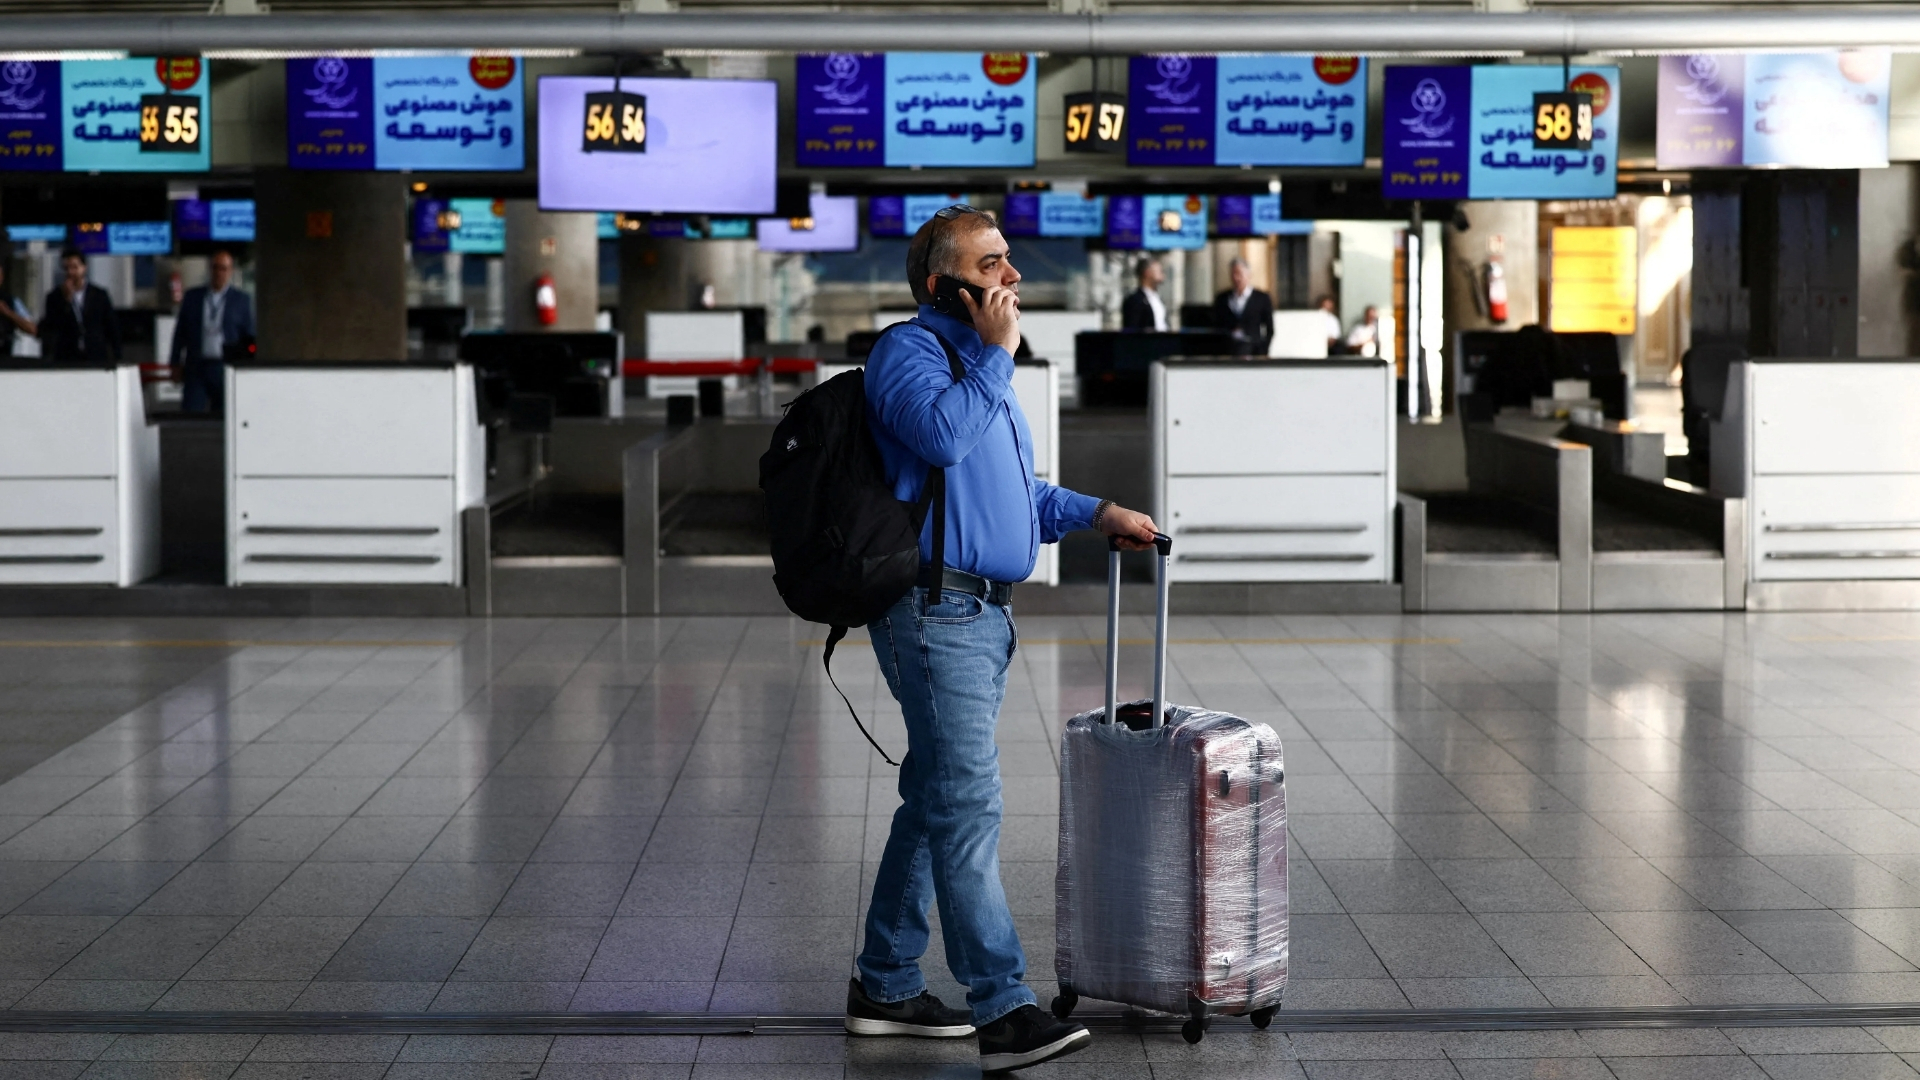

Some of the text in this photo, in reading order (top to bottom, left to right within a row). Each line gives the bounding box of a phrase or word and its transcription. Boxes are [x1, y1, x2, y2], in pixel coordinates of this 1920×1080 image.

[385, 93, 512, 117] هوش مصنوعی
[896, 89, 1024, 113] هوش مصنوعی
[1227, 88, 1355, 112] هوش مصنوعی
[164, 105, 199, 144] 55
[585, 103, 615, 141] 56
[621, 103, 646, 143] 56
[1066, 103, 1094, 142] 57
[1098, 103, 1124, 141] 57
[1535, 103, 1572, 140] 58
